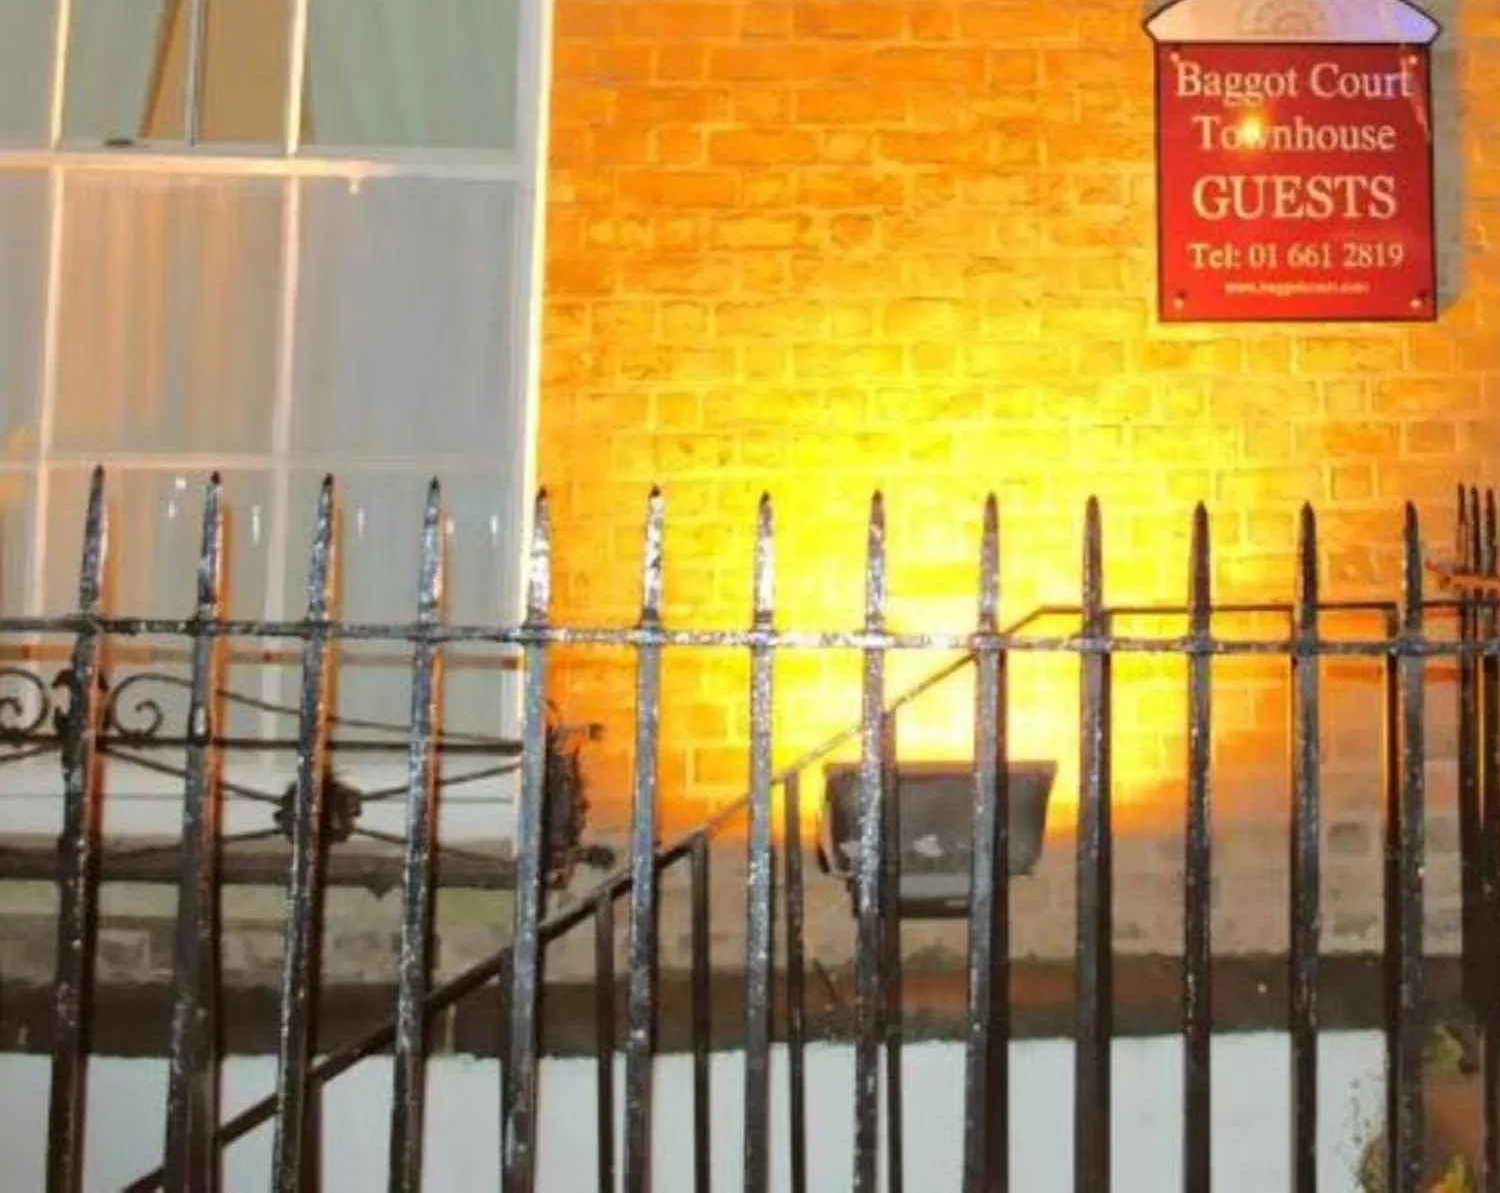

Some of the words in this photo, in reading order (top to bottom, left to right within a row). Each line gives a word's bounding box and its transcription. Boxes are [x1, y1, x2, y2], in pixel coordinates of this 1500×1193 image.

[1176, 61, 1298, 106] Baggot
[1310, 62, 1415, 98] Court
[1193, 174, 1398, 221] GUESTS
[1188, 242, 1242, 270] Tel:
[1249, 243, 1278, 269] 01
[1287, 243, 1331, 269] 661
[1343, 241, 1405, 269] 2819
